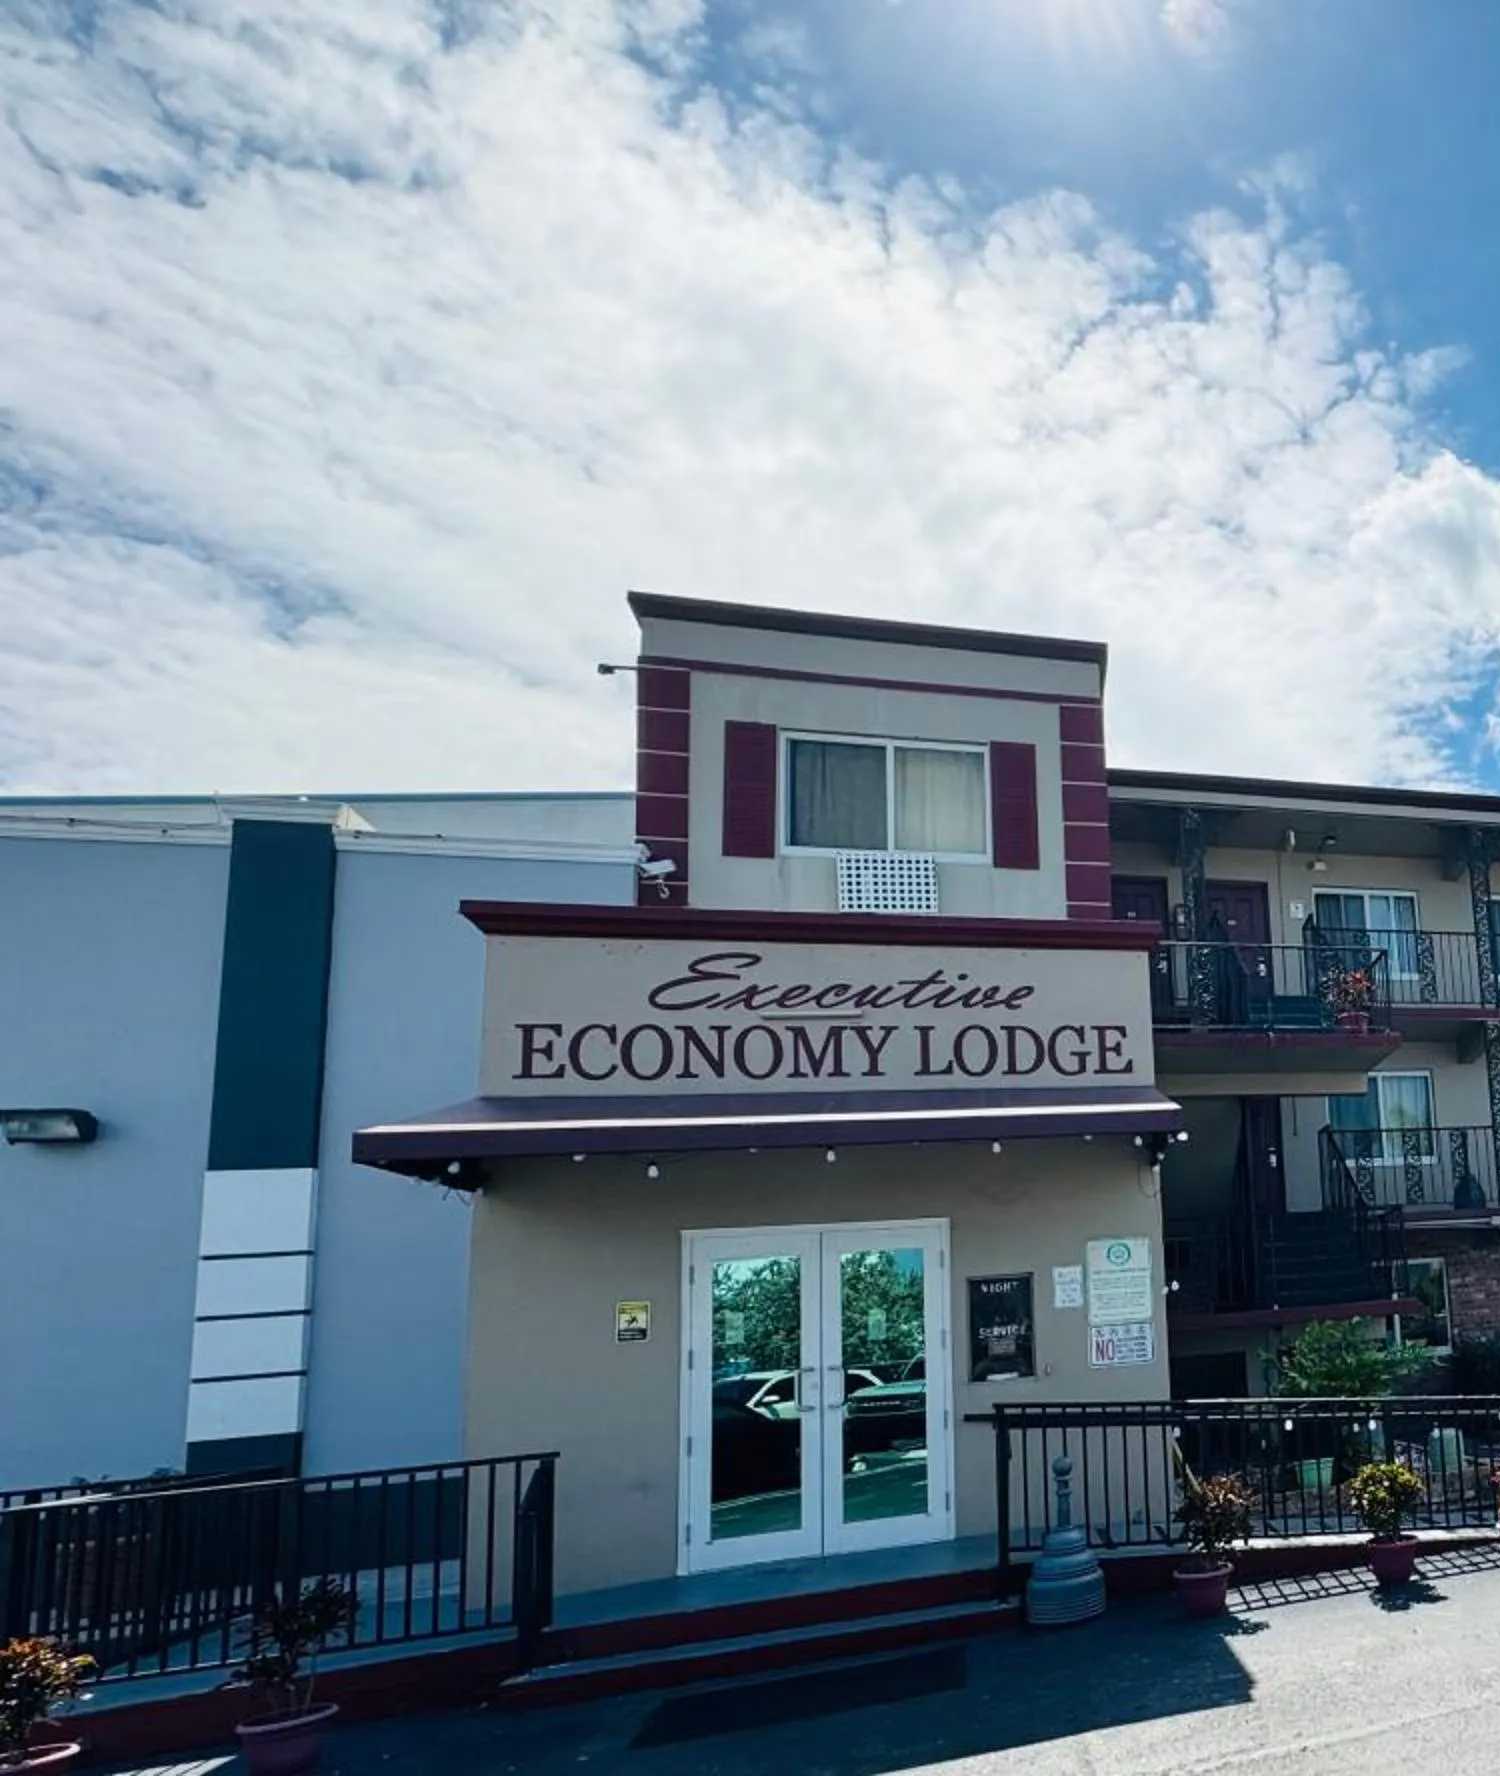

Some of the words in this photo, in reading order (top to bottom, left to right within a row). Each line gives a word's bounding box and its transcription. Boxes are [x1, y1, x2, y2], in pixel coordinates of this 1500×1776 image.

[648, 953, 1035, 1010] Executive
[512, 1023, 897, 1080] ECONOMY
[913, 1025, 1134, 1076] LODGE
[981, 1281, 1019, 1293] NIGHT
[1095, 1339, 1114, 1361] NO
